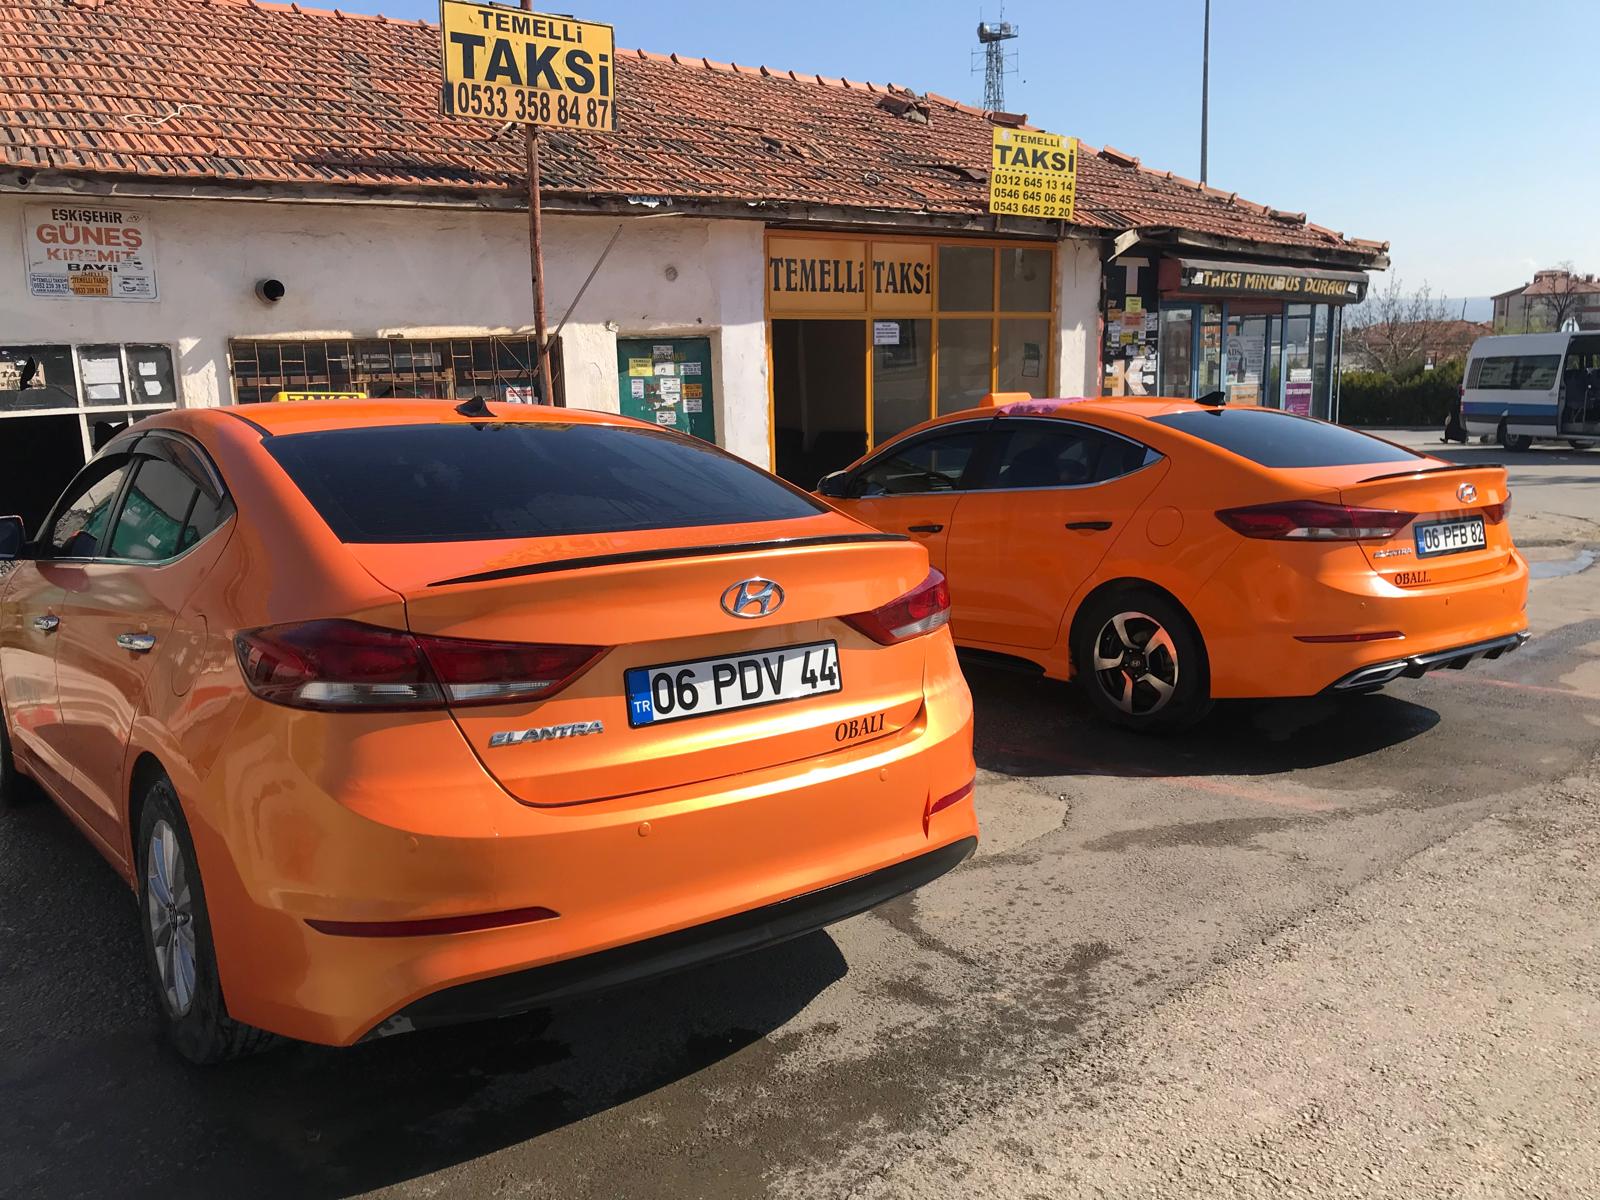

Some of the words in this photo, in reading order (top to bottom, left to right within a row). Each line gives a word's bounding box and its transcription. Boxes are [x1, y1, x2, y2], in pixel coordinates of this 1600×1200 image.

[457, 82, 508, 118] 0533
[514, 89, 551, 123] 358
[557, 94, 581, 125] 84
[586, 97, 609, 129] 87
[994, 187, 1020, 199] 0546
[1022, 191, 1042, 202] 645
[1044, 192, 1056, 202] 06
[1058, 194, 1071, 204] 45
[995, 174, 1021, 186] 0312
[1023, 177, 1043, 188] 645
[1046, 180, 1057, 190] 13
[1060, 181, 1072, 191] 14
[993, 201, 1019, 213] 0543
[1021, 203, 1040, 215] 645
[1043, 206, 1055, 216] 22
[1058, 207, 1070, 217] 20
[1424, 528, 1440, 549] 06
[1443, 526, 1468, 547] PFB
[1471, 523, 1483, 543] 82
[652, 669, 699, 715] 06
[712, 655, 784, 705] PDV
[801, 648, 836, 689] 44
[634, 700, 651, 713] TR
[488, 720, 604, 748] ELANTRA
[835, 713, 885, 742] OBALI
